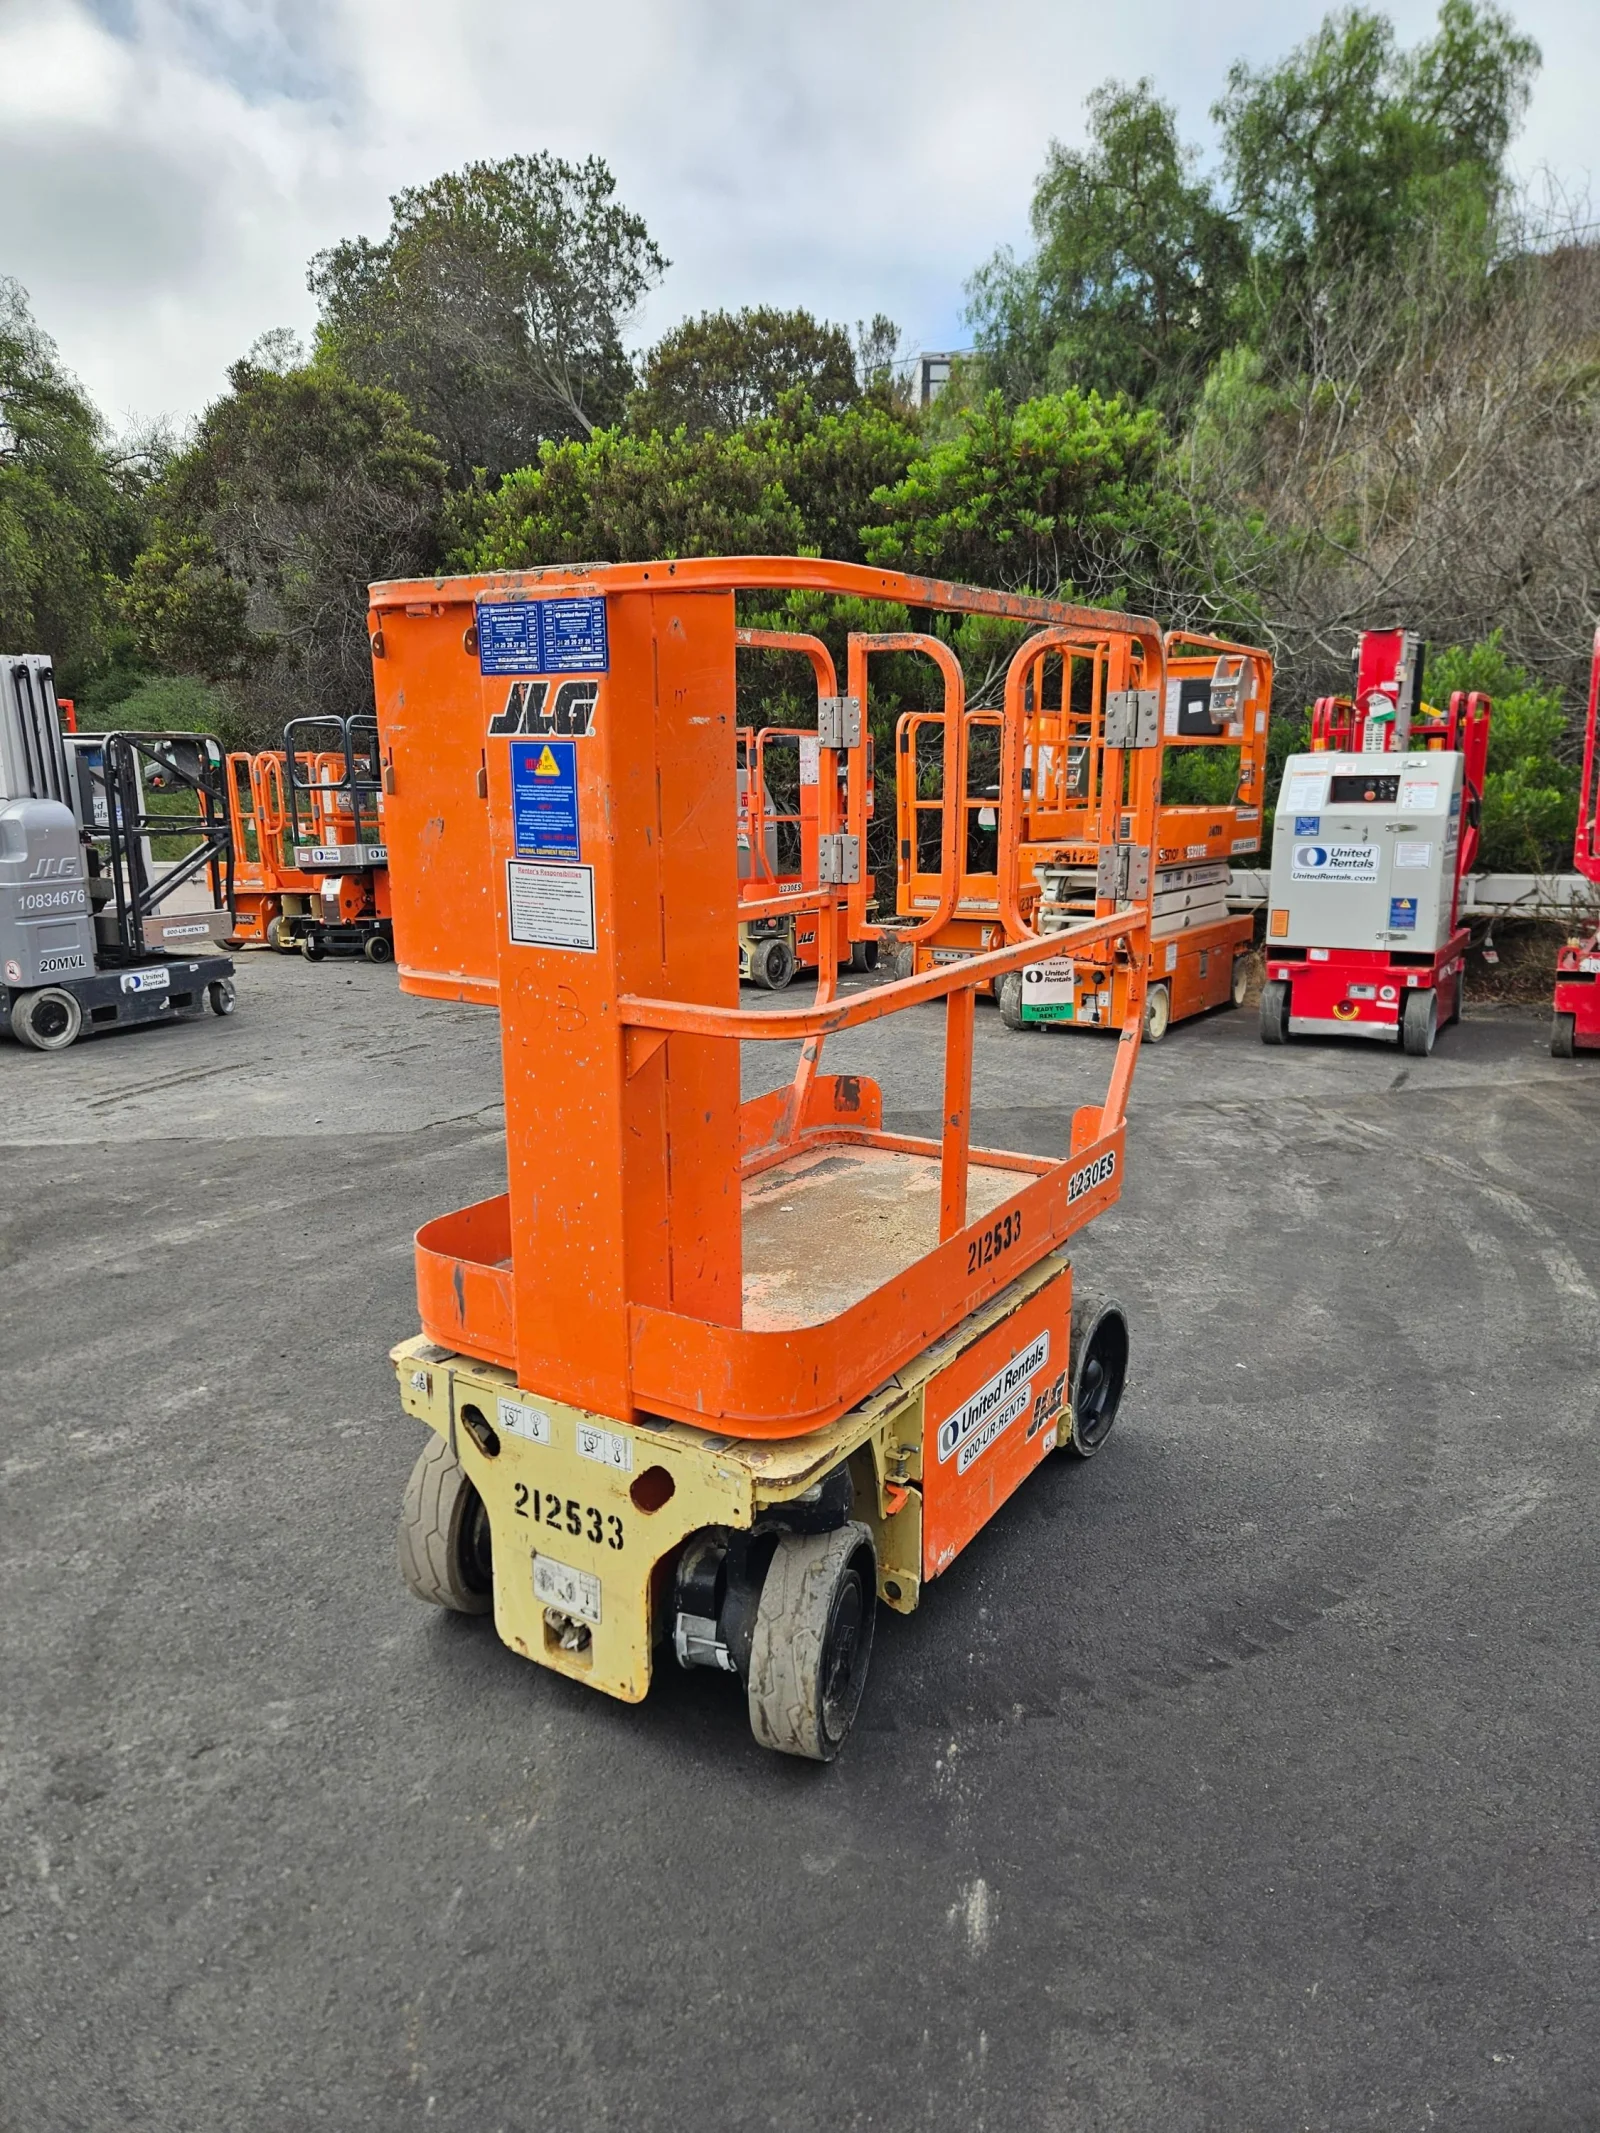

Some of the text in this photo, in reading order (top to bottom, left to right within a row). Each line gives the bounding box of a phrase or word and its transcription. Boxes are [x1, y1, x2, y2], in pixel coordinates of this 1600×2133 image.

[488, 680, 599, 737] JLG
[1331, 848, 1371, 857] United
[29, 856, 74, 879] JLG
[1329, 859, 1374, 868] Rentals
[540, 869, 581, 878] Responsibilities
[1293, 873, 1376, 881] UnitedRentals.com
[780, 883, 802, 893] 1230ES
[18, 890, 85, 910] 10834676
[798, 932, 815, 944] JLG
[40, 955, 86, 972] 20MVL
[142, 972, 164, 981] United
[143, 979, 167, 988] Rentals
[1068, 1152, 1114, 1202] 1230ES
[968, 1210, 1021, 1276] 212533
[962, 1346, 1044, 1433] United Rentals
[964, 1392, 1026, 1464] 800-UR-RENTS
[514, 1483, 624, 1550] 212533
